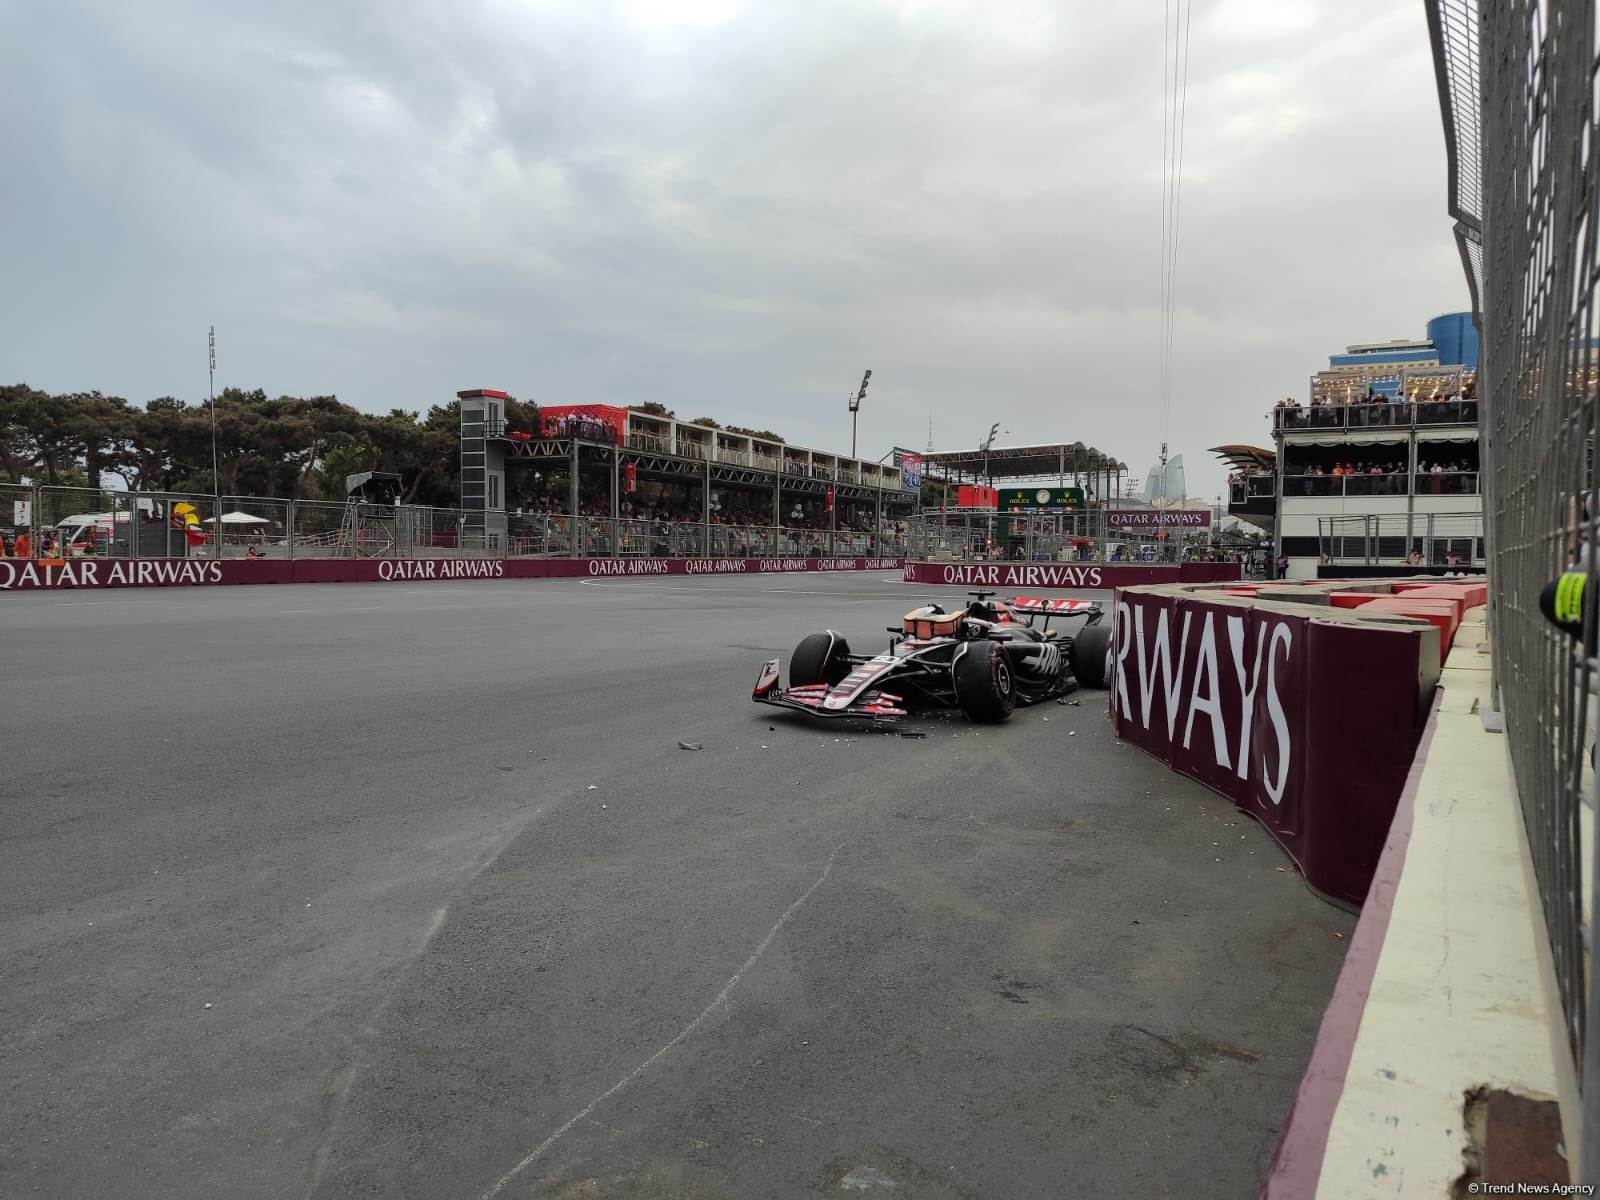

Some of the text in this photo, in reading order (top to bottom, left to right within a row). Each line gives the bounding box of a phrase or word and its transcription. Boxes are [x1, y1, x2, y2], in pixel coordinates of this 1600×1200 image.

[1110, 514, 1202, 525] QATAR AIRWAYS
[107, 560, 223, 585] AIRWAYS
[378, 560, 504, 581] QATAR AIRWAYS
[589, 559, 669, 576] QATAR AIRWAYS
[685, 559, 746, 574] QATAR AIRWAYS
[760, 558, 807, 572] QATAR AIRWAYS
[817, 558, 857, 571] QATAR AIRWAYS
[943, 565, 1102, 586] QATAR AIRWAYS
